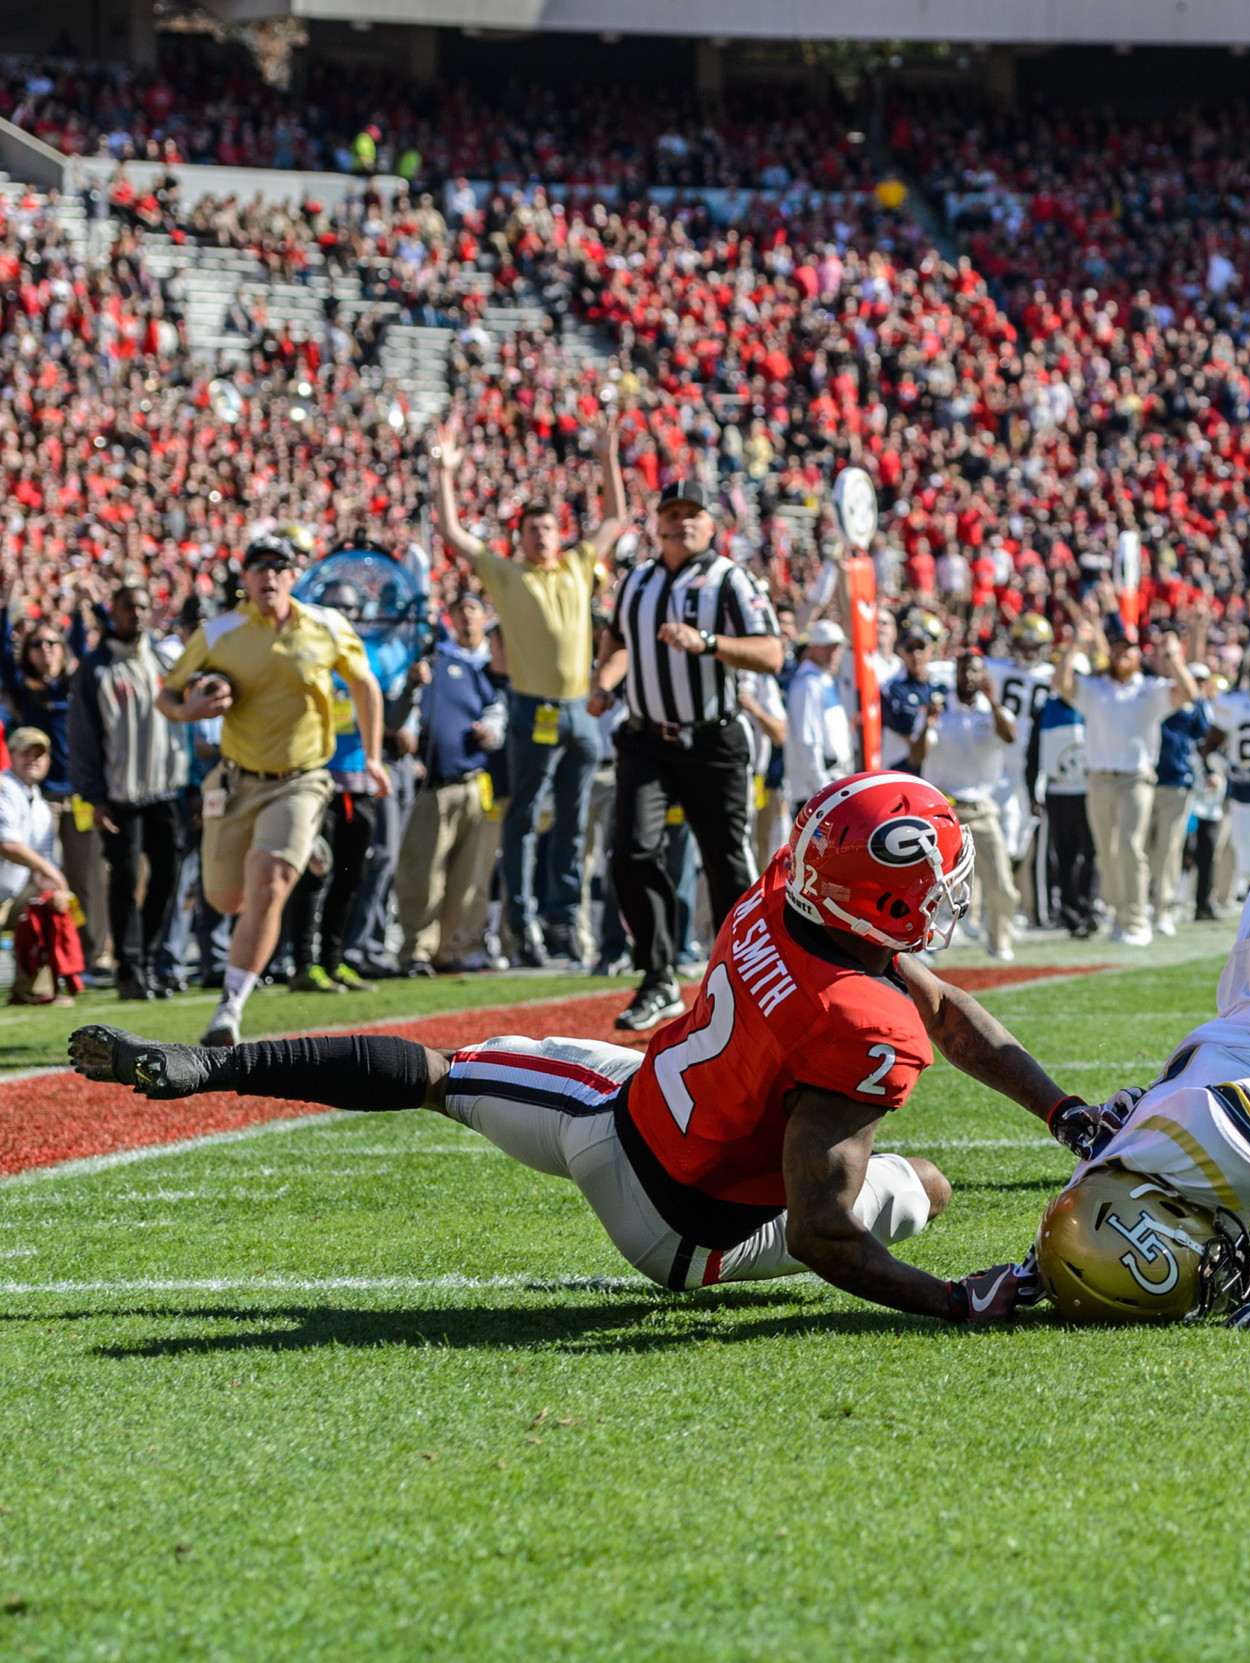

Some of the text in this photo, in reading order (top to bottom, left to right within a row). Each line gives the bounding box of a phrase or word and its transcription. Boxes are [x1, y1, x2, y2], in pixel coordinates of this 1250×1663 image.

[684, 599, 697, 618] L
[869, 817, 936, 866] G
[804, 864, 818, 896] 2
[732, 888, 798, 1018] M. SMITH
[653, 961, 736, 1139] 2
[855, 1043, 896, 1096] 2
